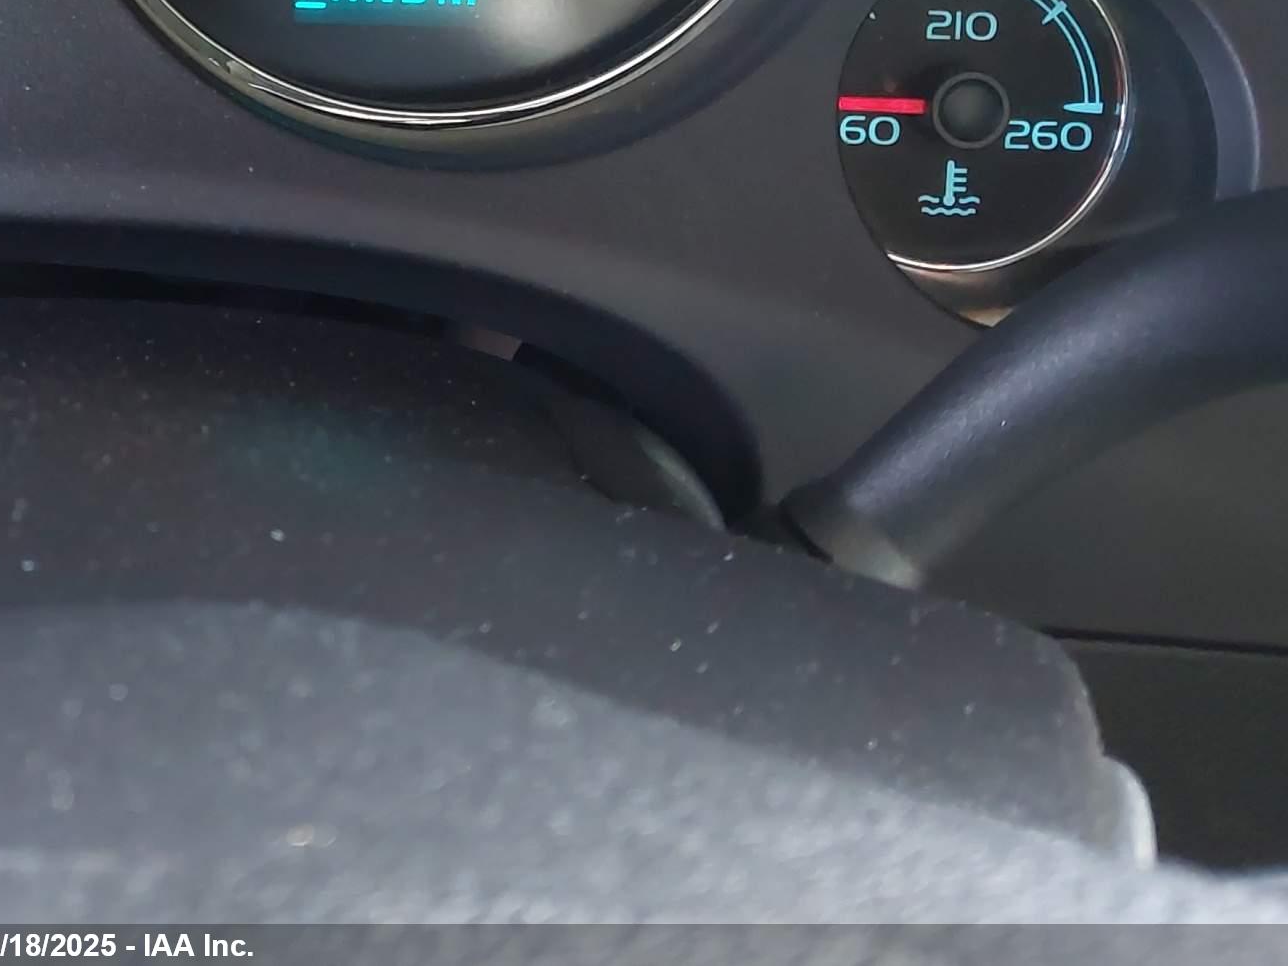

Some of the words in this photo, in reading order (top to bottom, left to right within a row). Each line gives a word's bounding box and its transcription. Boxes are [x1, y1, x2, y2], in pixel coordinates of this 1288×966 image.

[926, 10, 998, 41] 210
[839, 115, 900, 145] 60
[1004, 120, 1092, 151] 260
